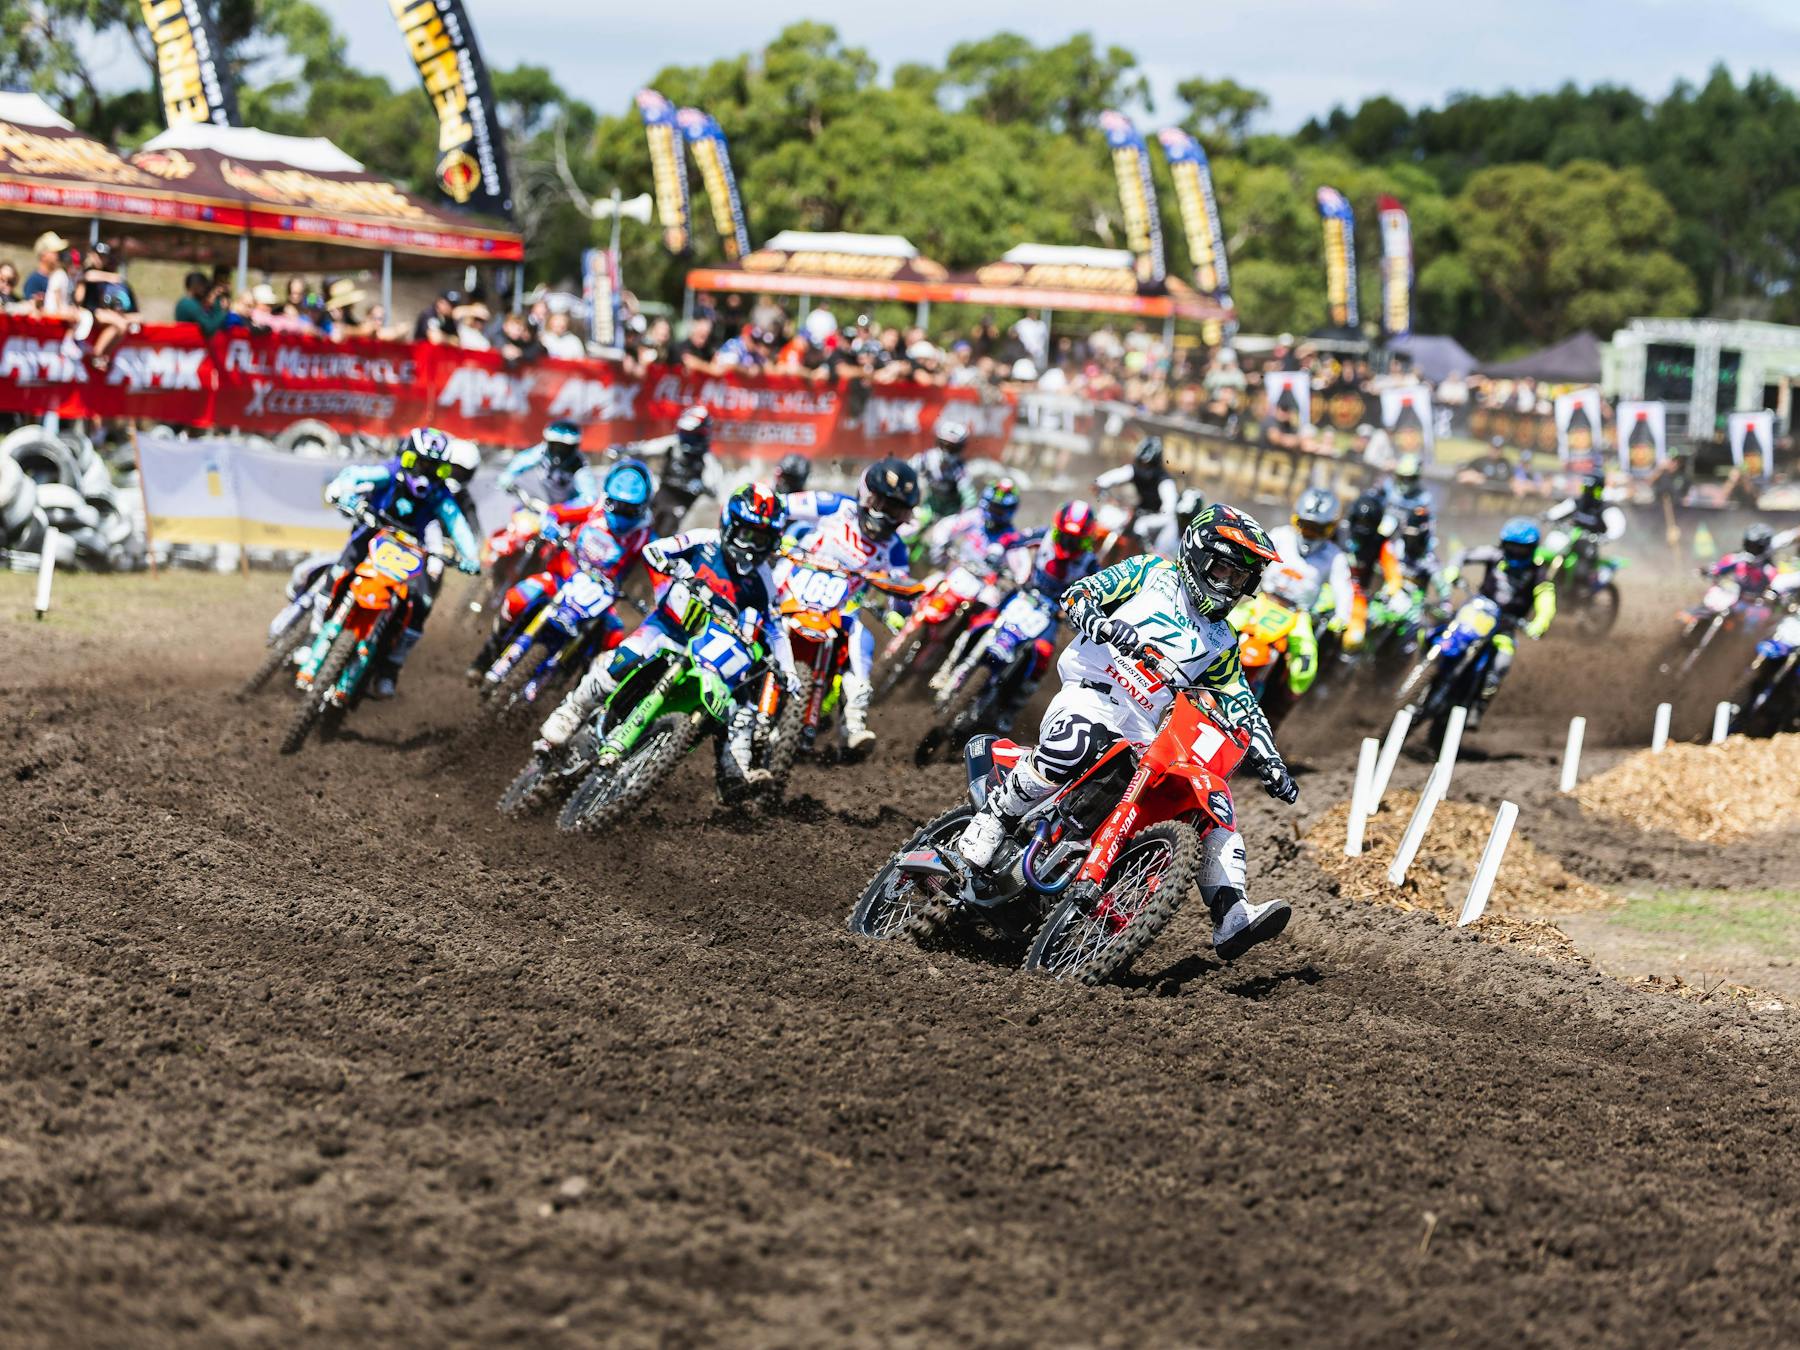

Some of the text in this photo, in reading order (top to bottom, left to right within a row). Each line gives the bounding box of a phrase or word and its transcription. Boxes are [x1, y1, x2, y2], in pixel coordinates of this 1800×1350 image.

[106, 346, 206, 395] AMX
[437, 365, 536, 419] AMX
[547, 376, 641, 425] AMX
[699, 627, 752, 680] 11
[1113, 655, 1150, 689] LOGISTICS
[1104, 664, 1155, 712] HONDA
[1190, 721, 1227, 764] 1
